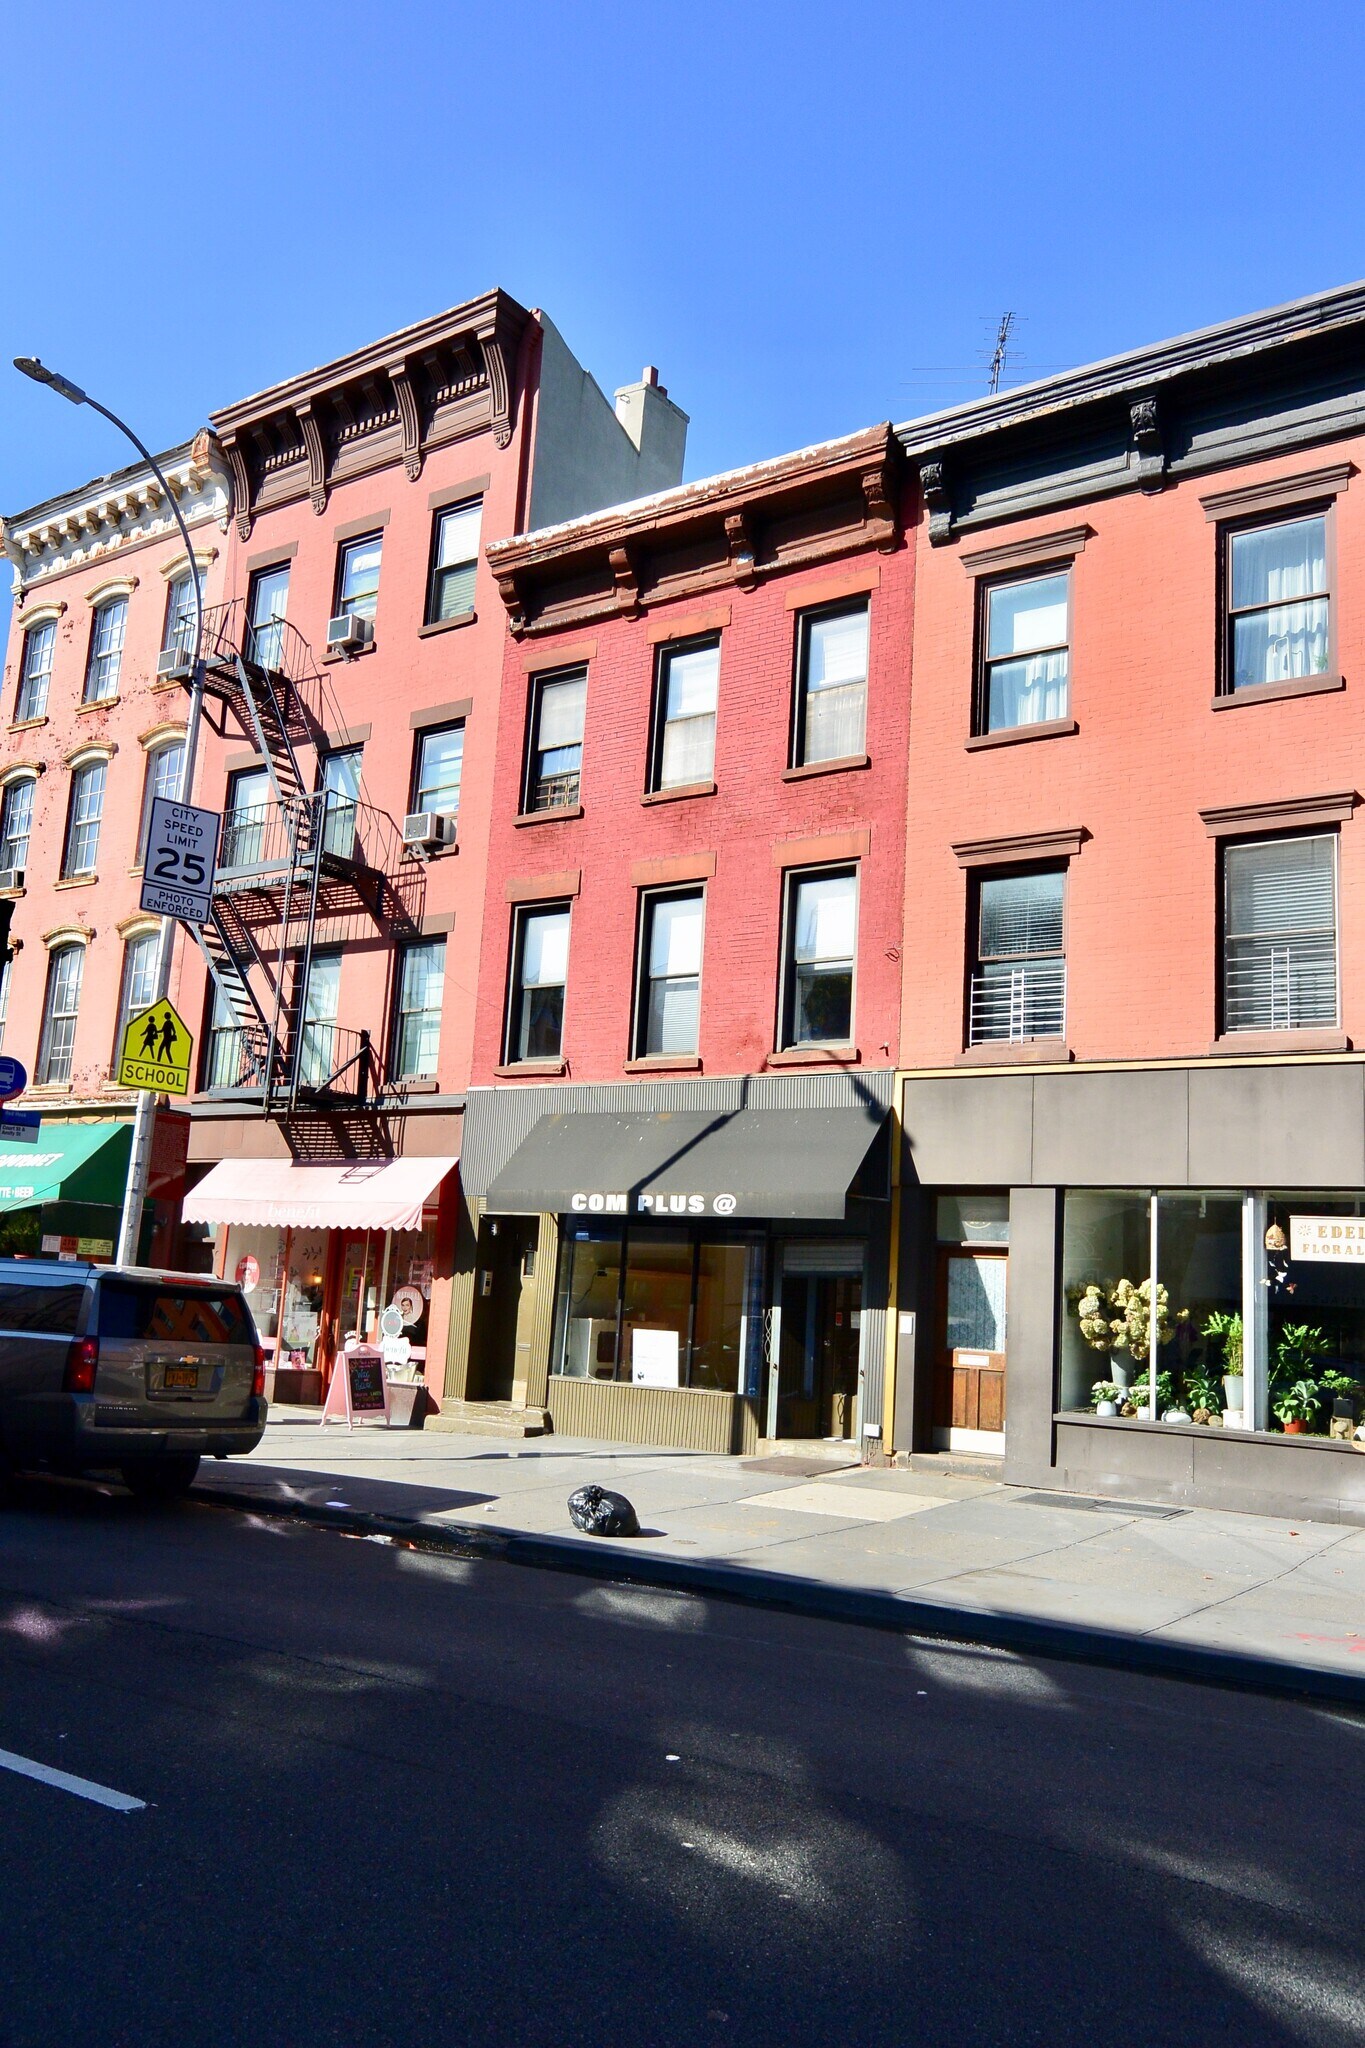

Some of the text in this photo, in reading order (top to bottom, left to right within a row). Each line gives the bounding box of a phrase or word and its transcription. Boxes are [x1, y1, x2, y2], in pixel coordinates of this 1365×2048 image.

[172, 807, 199, 822] CITY
[164, 819, 203, 837] SPEED
[166, 833, 198, 849] LIMIT
[153, 847, 206, 885] 25
[146, 898, 203, 918] ENFORCED
[159, 891, 194, 907] PHOTO
[124, 1064, 184, 1087] SCHOOL
[571, 1193, 738, 1215] COM PLUS @
[1302, 1243, 1364, 1256] FLORAL
